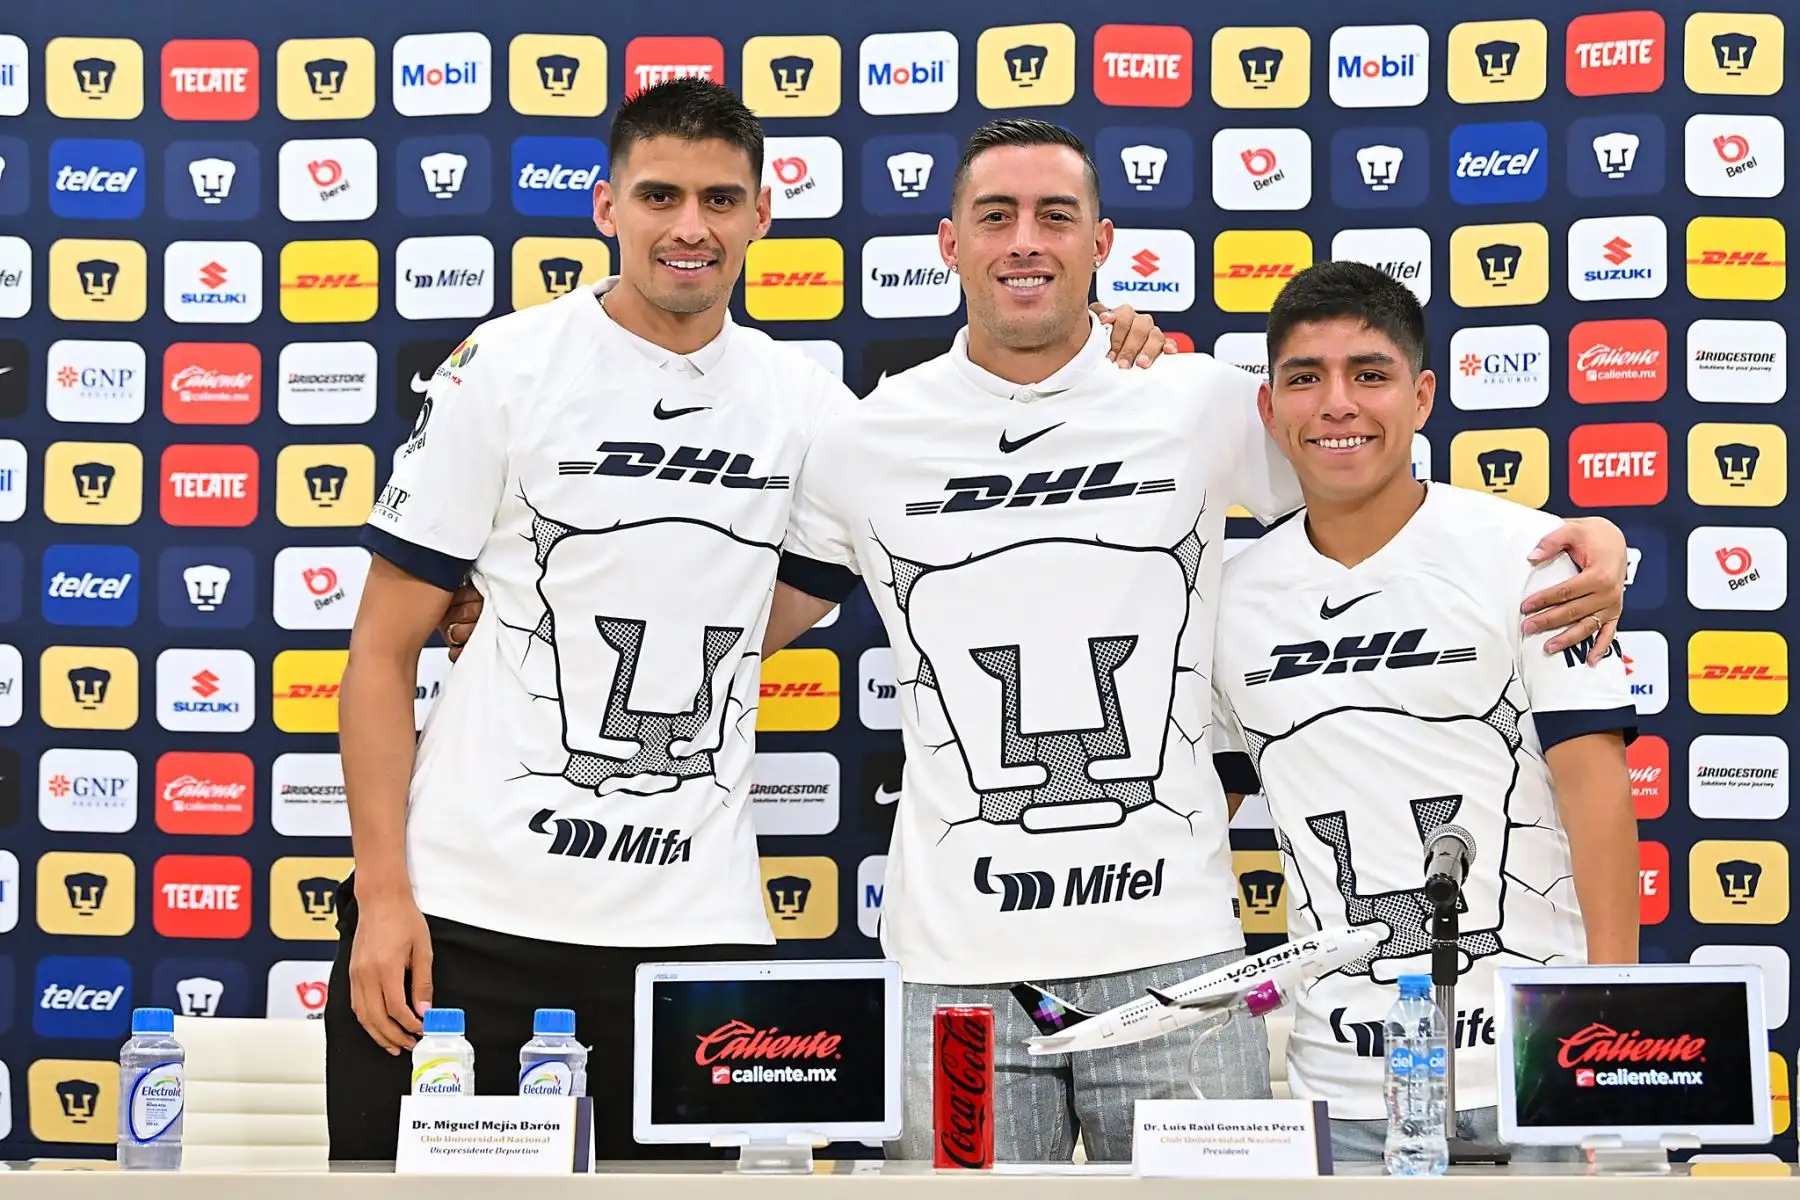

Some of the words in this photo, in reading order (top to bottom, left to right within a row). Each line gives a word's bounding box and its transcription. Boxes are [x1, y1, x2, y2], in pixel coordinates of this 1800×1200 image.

[1576, 39, 1653, 68] TECATE
[403, 62, 475, 86] Mobil
[869, 61, 943, 85] Mobil
[1103, 53, 1181, 79] TECATE
[1338, 55, 1413, 77] Mobil
[171, 68, 248, 92] TECATE
[1457, 148, 1539, 177] telcel
[1726, 156, 1758, 177] Berel
[56, 166, 137, 192] telcel
[518, 163, 601, 190] telcel
[1253, 169, 1285, 191] Berel
[320, 180, 351, 200] Berel
[785, 177, 816, 199] Berel
[1700, 251, 1772, 266] DHL
[295, 274, 363, 287] DHL
[437, 269, 483, 287] Mifel
[759, 271, 829, 286] DHL
[902, 267, 950, 286] Mifel
[1228, 264, 1297, 278] DHL
[1584, 268, 1652, 281] SUZUKI
[1113, 281, 1180, 292] SUZUKI
[182, 294, 246, 303] SUZUKI
[1484, 352, 1537, 374] GNP
[1577, 344, 1659, 371] Caliente
[1695, 350, 1777, 363] BRIDGESTONE
[82, 369, 132, 387] GNP
[1598, 370, 1656, 381] caliente.mx
[593, 441, 770, 490] DHL
[1578, 451, 1656, 478] TECATE
[170, 473, 247, 498] TECATE
[940, 461, 1138, 513] DHL
[49, 572, 131, 598] telcel
[1728, 569, 1760, 591] Berel
[314, 588, 345, 610] Berel
[1268, 628, 1443, 683] DHL
[1702, 665, 1775, 680] DHL
[288, 684, 340, 698] DH
[760, 682, 825, 698] DHL
[174, 702, 238, 712] SUZUKI
[1697, 767, 1779, 779] BRIDGESTONE
[73, 776, 125, 797] GNP
[164, 774, 246, 801] Caliente
[749, 783, 830, 795] BRIDGESTONE
[1063, 859, 1164, 906] Mifel
[162, 884, 240, 909] TECATE
[41, 984, 124, 1010] telcel
[1455, 1007, 1495, 1049] ife
[695, 1019, 842, 1066] Caliente
[1556, 1022, 1707, 1068] Caliente
[732, 1066, 837, 1083] caliente.mx
[1596, 1068, 1703, 1086] caliente.mx
[419, 1083, 463, 1093] Electrolit
[523, 1084, 562, 1095] Electrolit
[940, 1014, 987, 1169] Coca-Cola
[412, 1121, 431, 1130] Dr.
[434, 1120, 480, 1132] Miguel
[482, 1120, 517, 1133] Mejía
[520, 1121, 560, 1131] Barón
[1143, 1123, 1160, 1132] Dr.
[1163, 1123, 1187, 1132] Luis
[420, 1135, 443, 1143] Club
[430, 1147, 493, 1155] Vicepresidente
